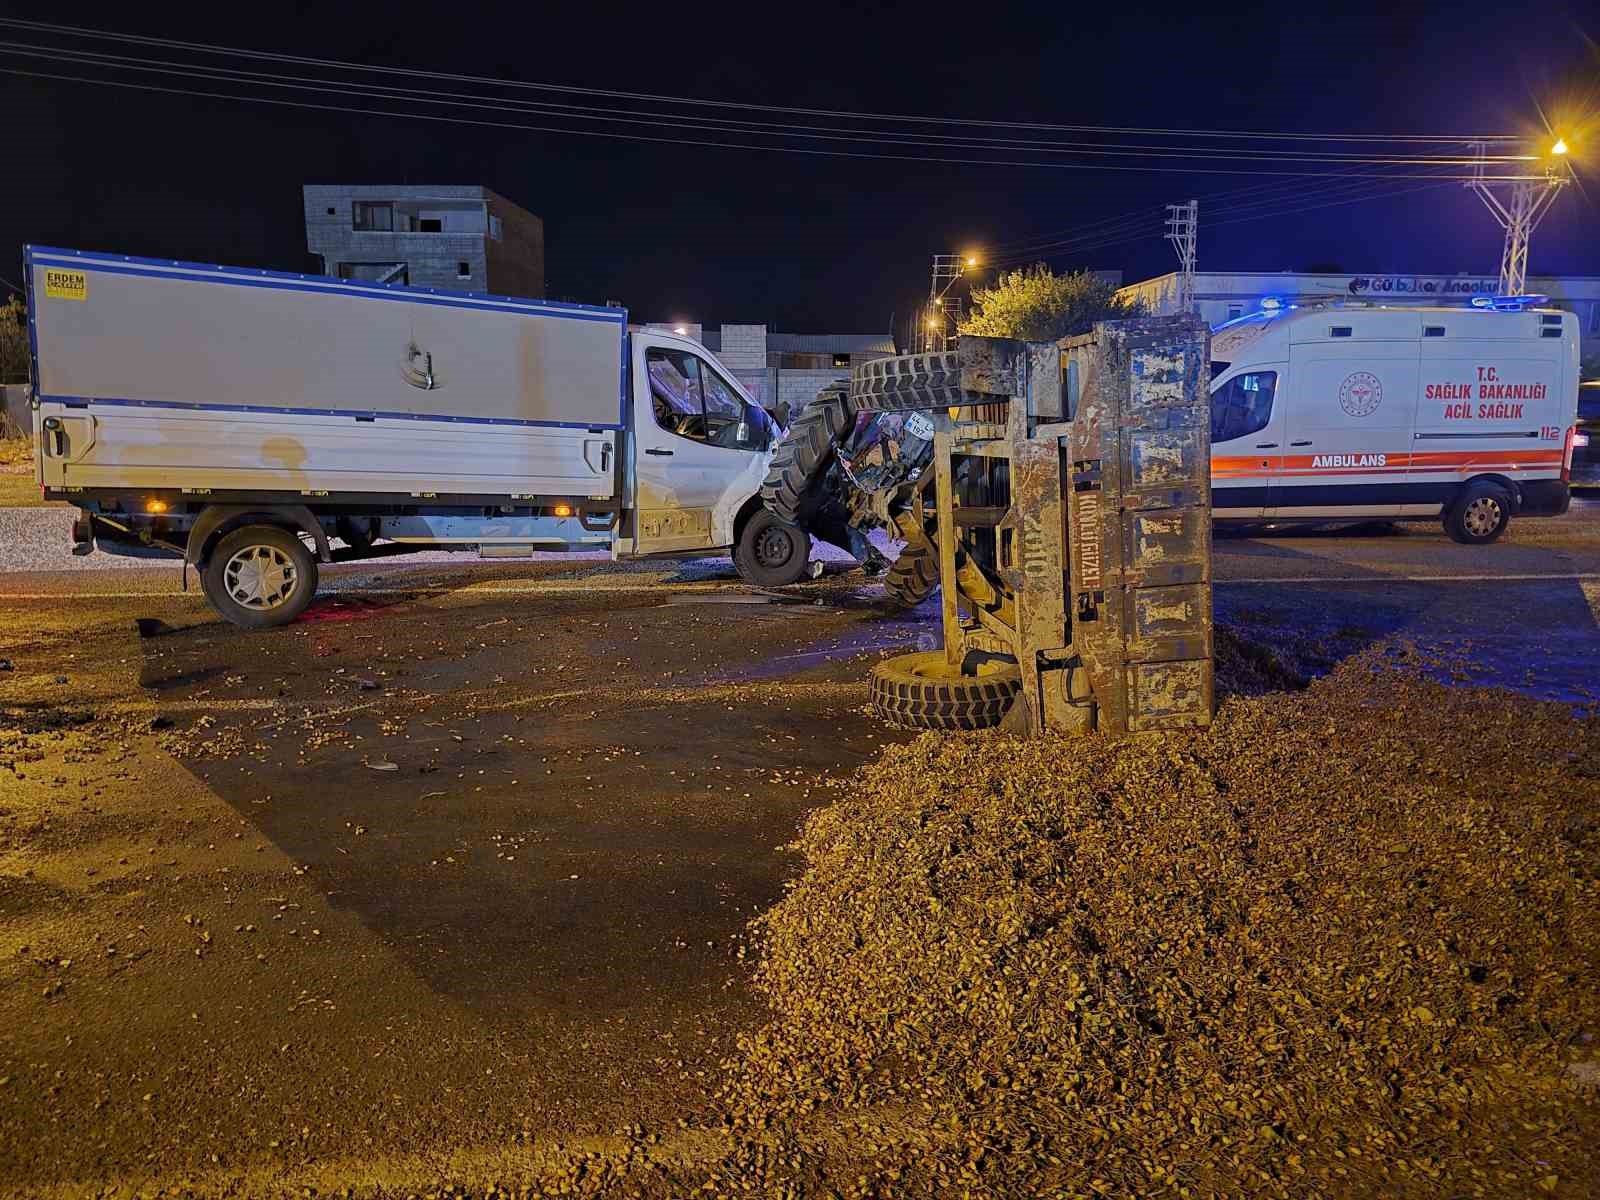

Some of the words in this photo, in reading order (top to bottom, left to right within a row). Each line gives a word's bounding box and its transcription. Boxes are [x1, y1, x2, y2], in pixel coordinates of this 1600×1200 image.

[47, 272, 84, 283] ERDEM
[1476, 366, 1499, 382] T.C.
[1425, 382, 1472, 400] SAĞLIK
[1479, 382, 1547, 400] BAKANLIĞI
[1444, 401, 1473, 419] ACİL
[1478, 402, 1524, 419] SAĞLIK
[1540, 426, 1560, 440] 112
[1311, 454, 1386, 468] AMBULANS
